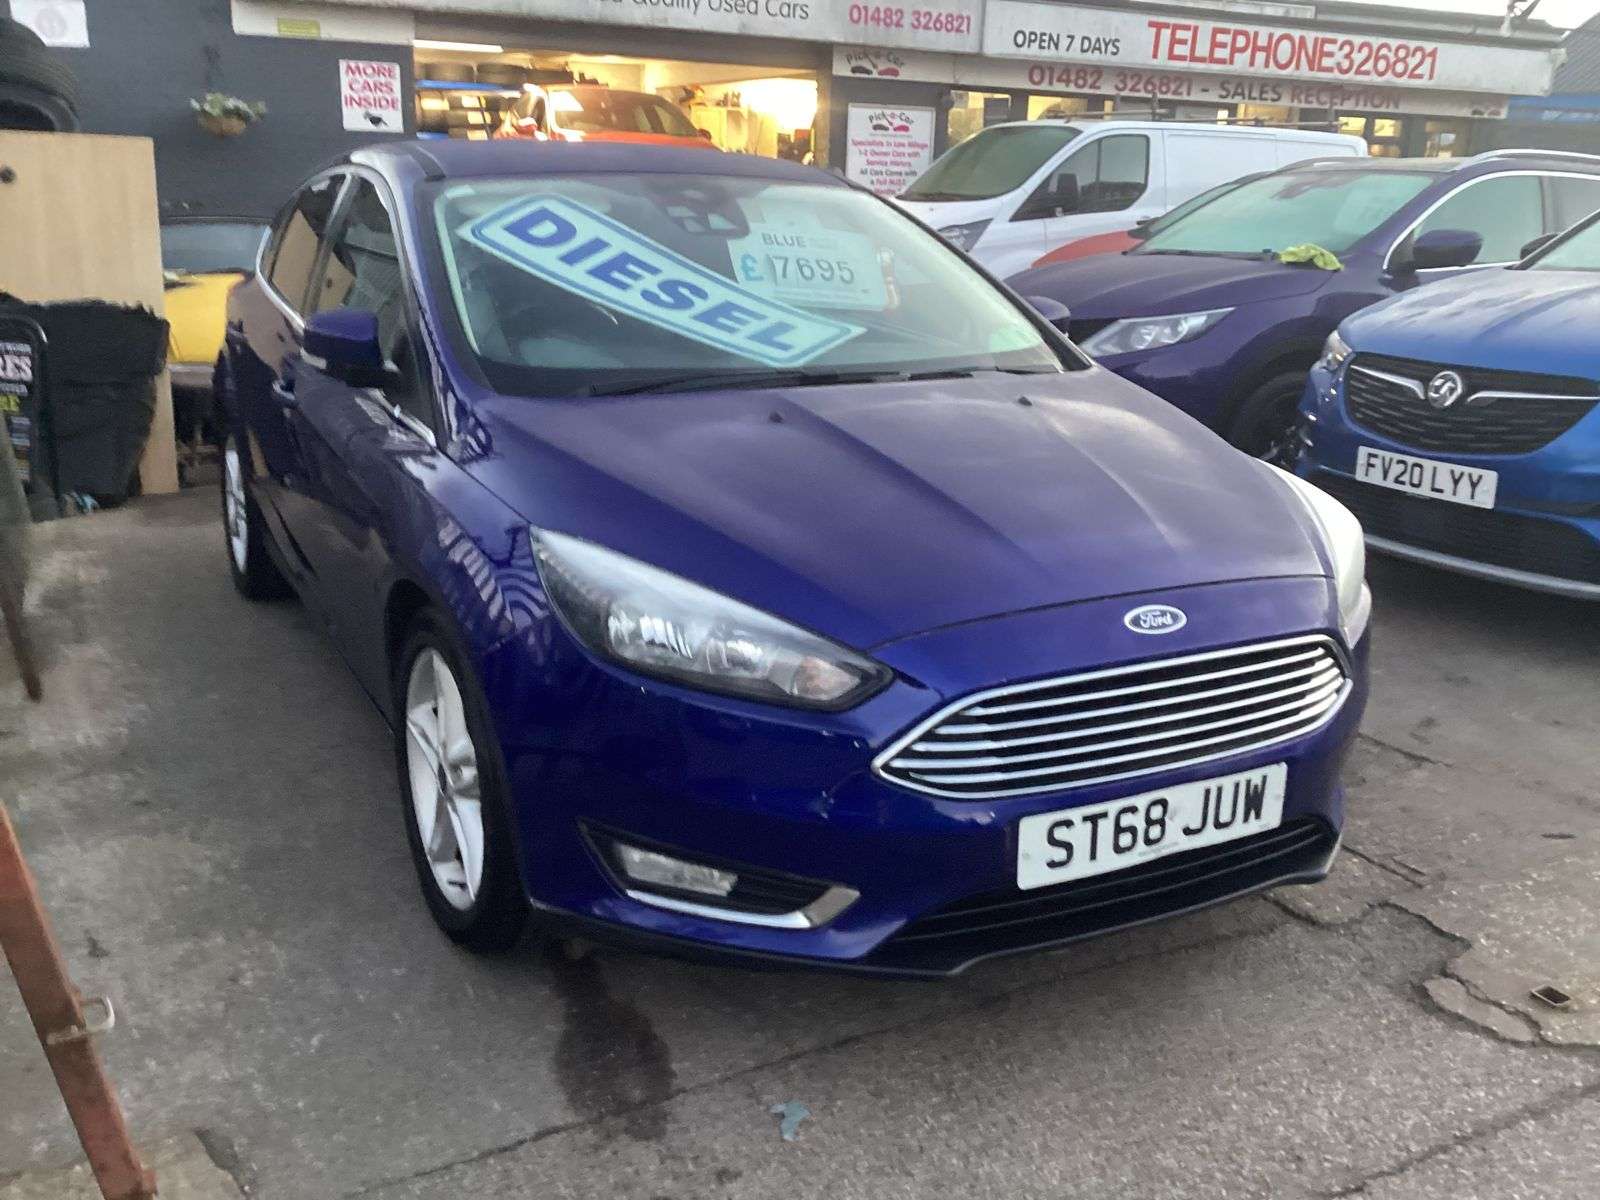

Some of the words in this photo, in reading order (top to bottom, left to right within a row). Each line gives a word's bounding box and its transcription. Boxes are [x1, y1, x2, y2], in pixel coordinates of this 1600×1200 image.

[708, 0, 759, 16] Used
[764, 1, 809, 19] Cars
[848, 4, 904, 29] 01482
[911, 10, 971, 35] 326821
[1013, 29, 1060, 51] OPEN
[1065, 35, 1076, 52] 7
[1080, 36, 1121, 56] DAYS
[345, 63, 394, 78] MORE
[347, 78, 394, 93] CARS
[1027, 64, 1104, 90] 01482
[1114, 71, 1193, 97] 326821
[1218, 80, 1282, 102] SALES
[1290, 86, 1400, 109] RECEPTION
[344, 94, 398, 110] INSIDE
[761, 232, 807, 248] BLUE
[503, 207, 796, 352] DIESEL
[1364, 452, 1424, 488] FV20
[1430, 466, 1483, 500] LYY
[1139, 610, 1174, 628] Ford
[1046, 798, 1169, 868] ST68
[1182, 775, 1268, 836] JUW
